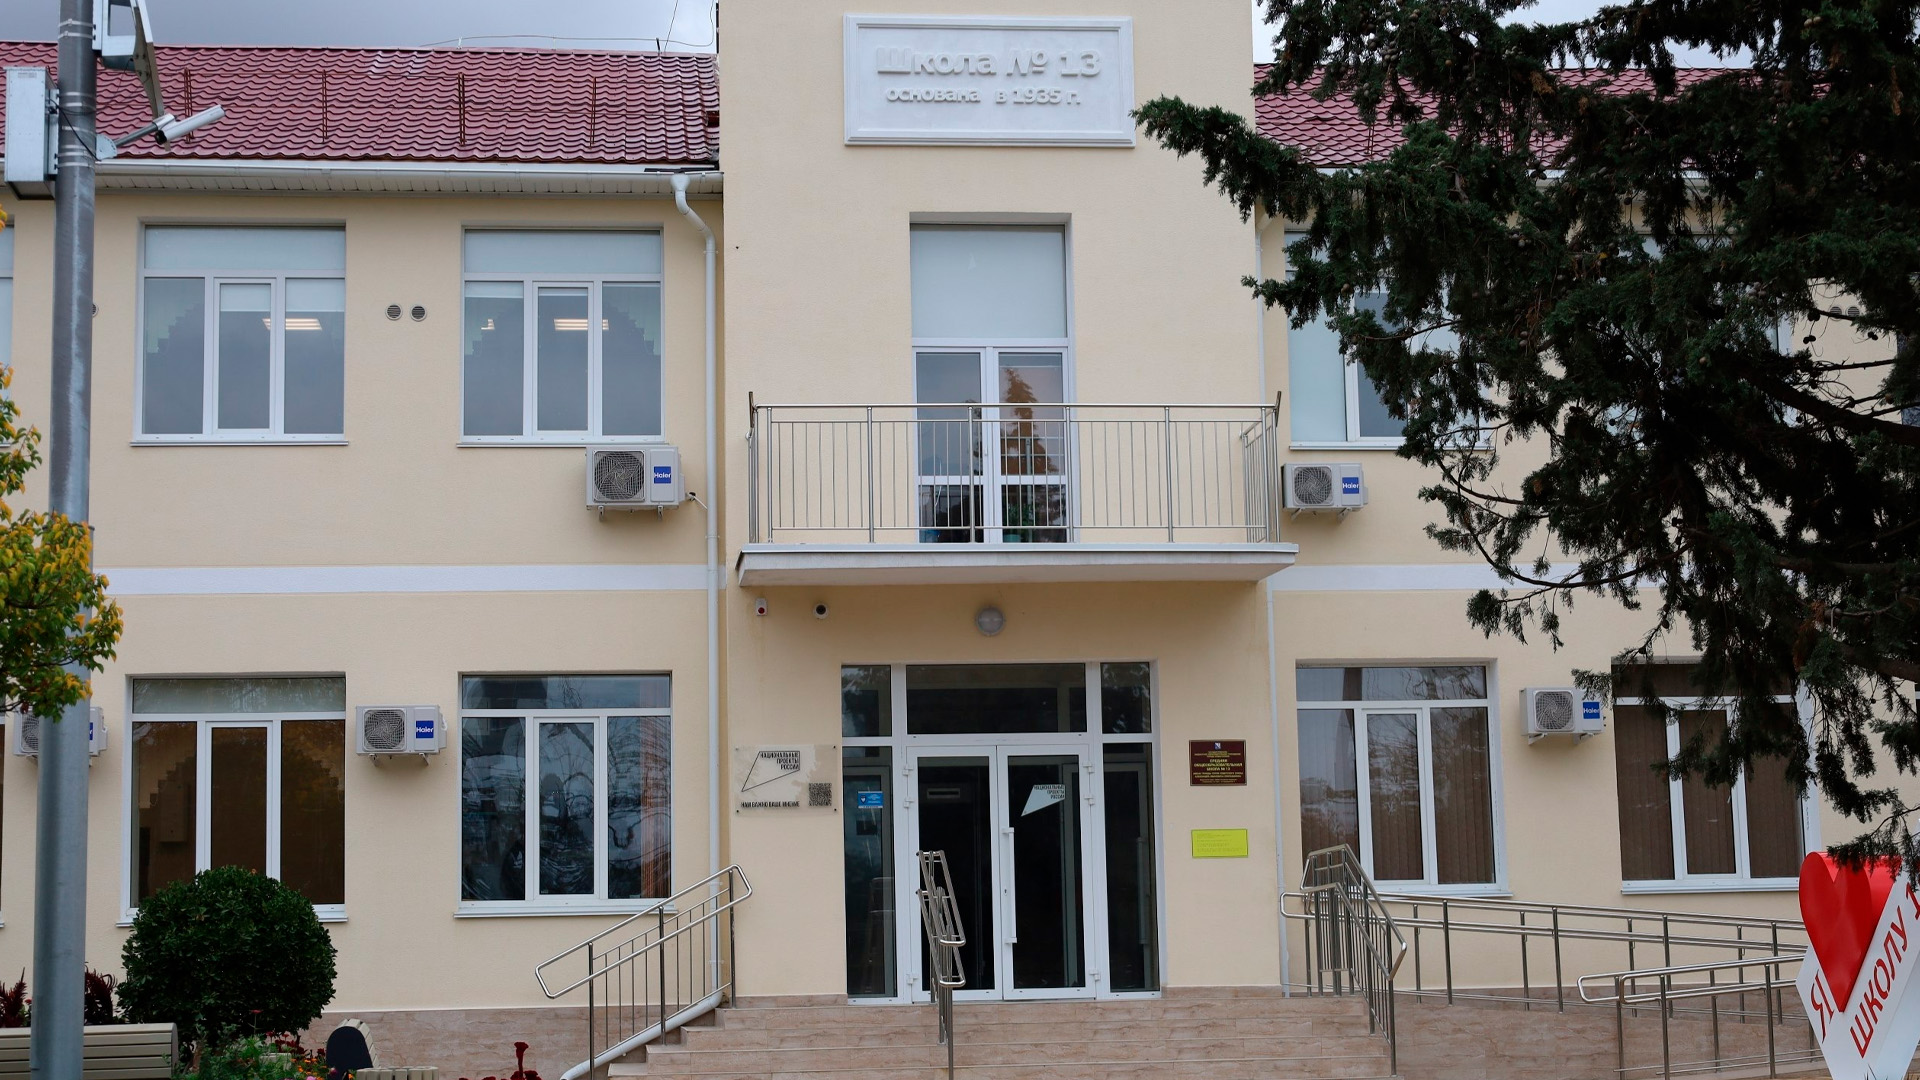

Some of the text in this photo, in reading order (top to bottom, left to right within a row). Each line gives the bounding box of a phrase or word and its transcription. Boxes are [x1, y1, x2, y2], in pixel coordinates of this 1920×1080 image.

[876, 47, 1101, 77] Школа № 13
[886, 88, 981, 104] основана
[995, 90, 1007, 104] в
[1012, 88, 1062, 105] 1935
[1810, 969, 1835, 1044] Я
[1850, 905, 1908, 1059] ШКОЛУ
